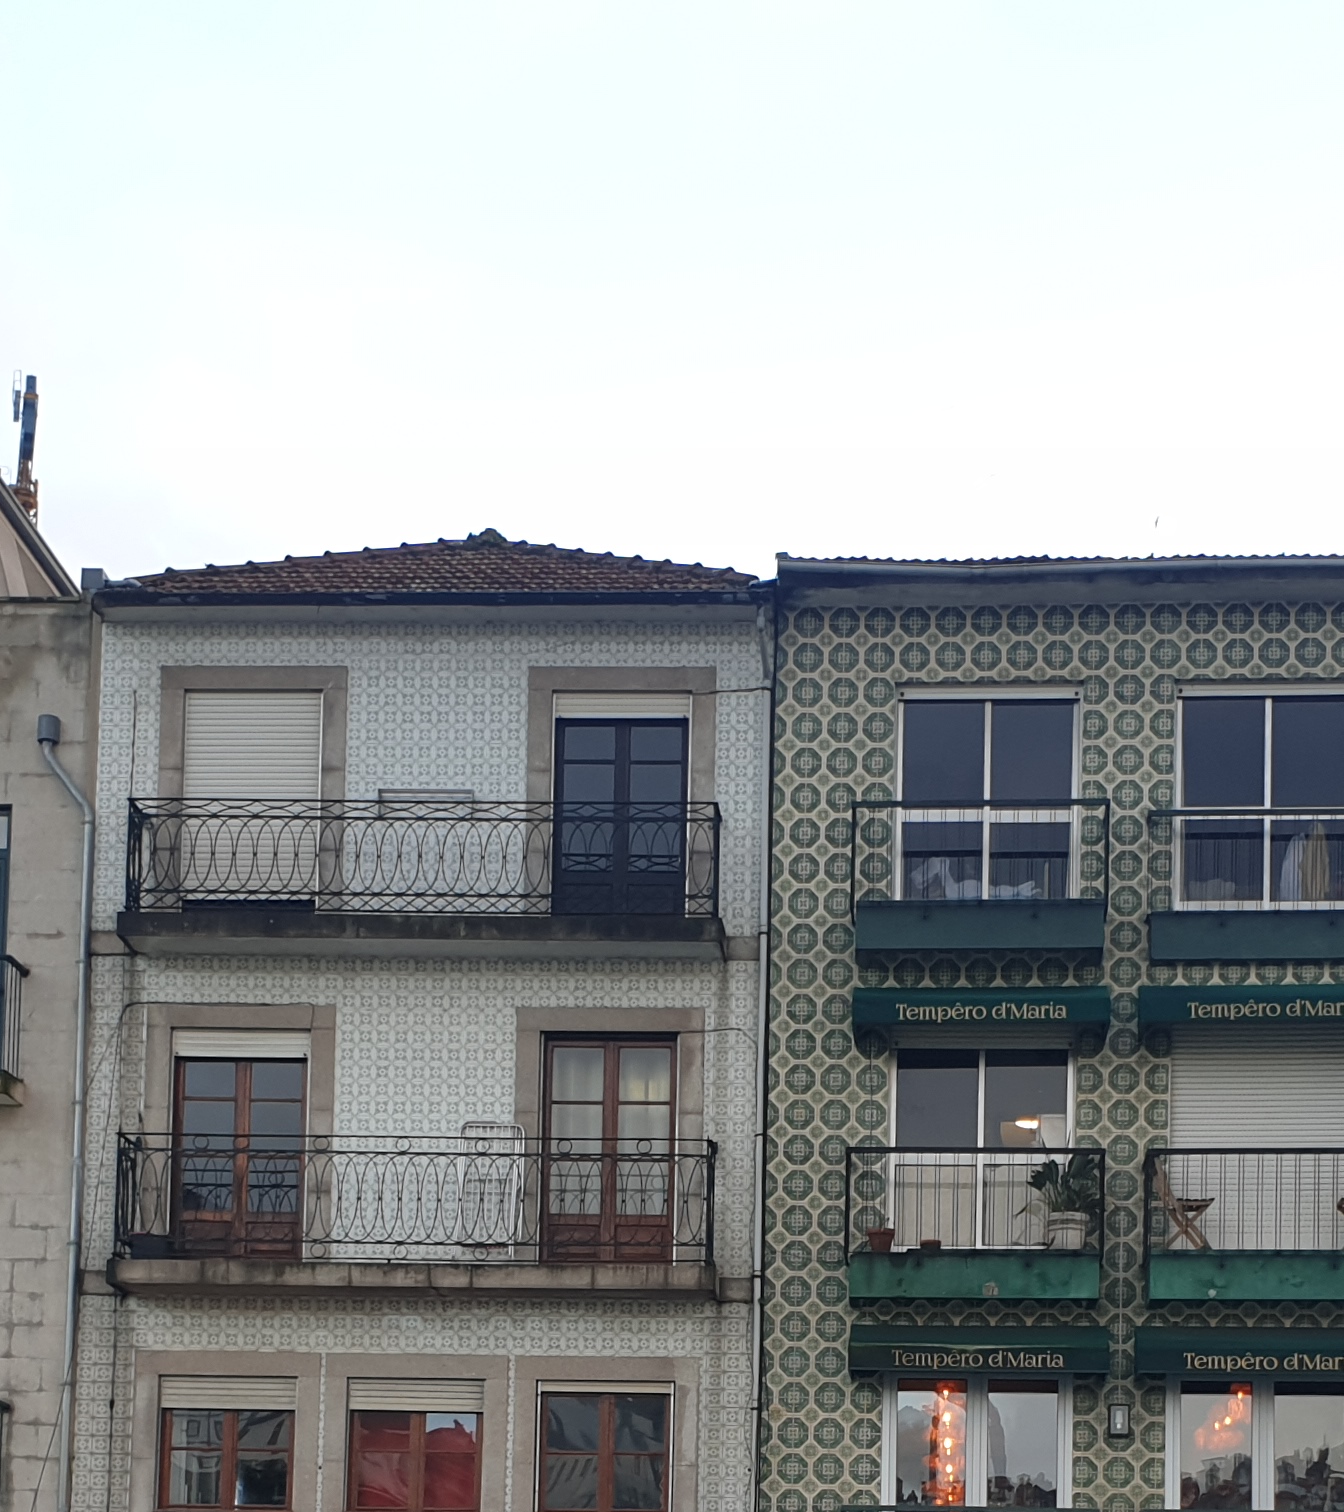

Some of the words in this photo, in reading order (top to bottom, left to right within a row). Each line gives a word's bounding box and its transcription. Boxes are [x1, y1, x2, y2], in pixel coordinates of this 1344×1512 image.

[896, 1002, 987, 1023] Tempêro
[992, 1001, 1067, 1020] d'Maria
[1187, 999, 1281, 1021] Tempêro
[892, 1349, 983, 1370] Tempêro
[988, 1350, 1064, 1368] d'Maria
[1183, 1352, 1279, 1373] Tempêro
